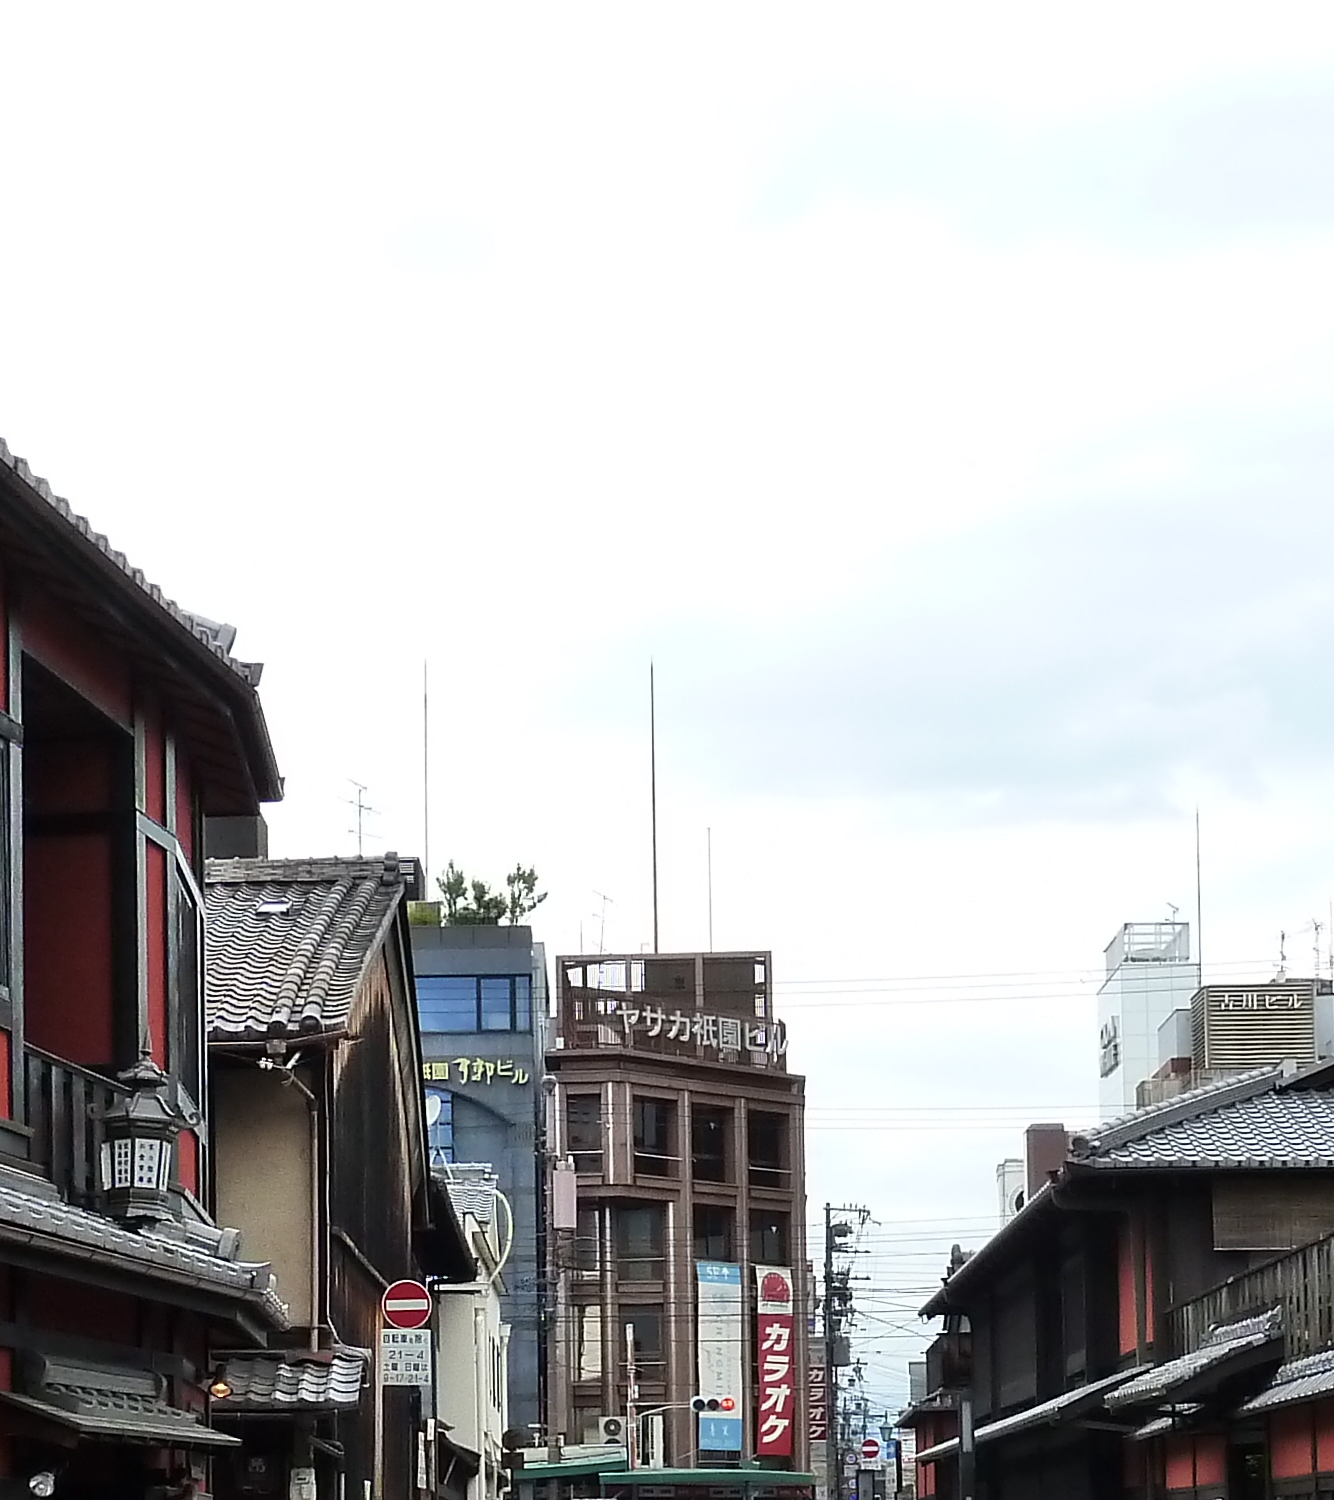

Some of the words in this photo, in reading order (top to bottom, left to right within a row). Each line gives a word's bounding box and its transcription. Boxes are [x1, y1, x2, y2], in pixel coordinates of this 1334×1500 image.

[761, 1323, 791, 1444] カラオケ
[808, 1367, 826, 1440] カラオケ
